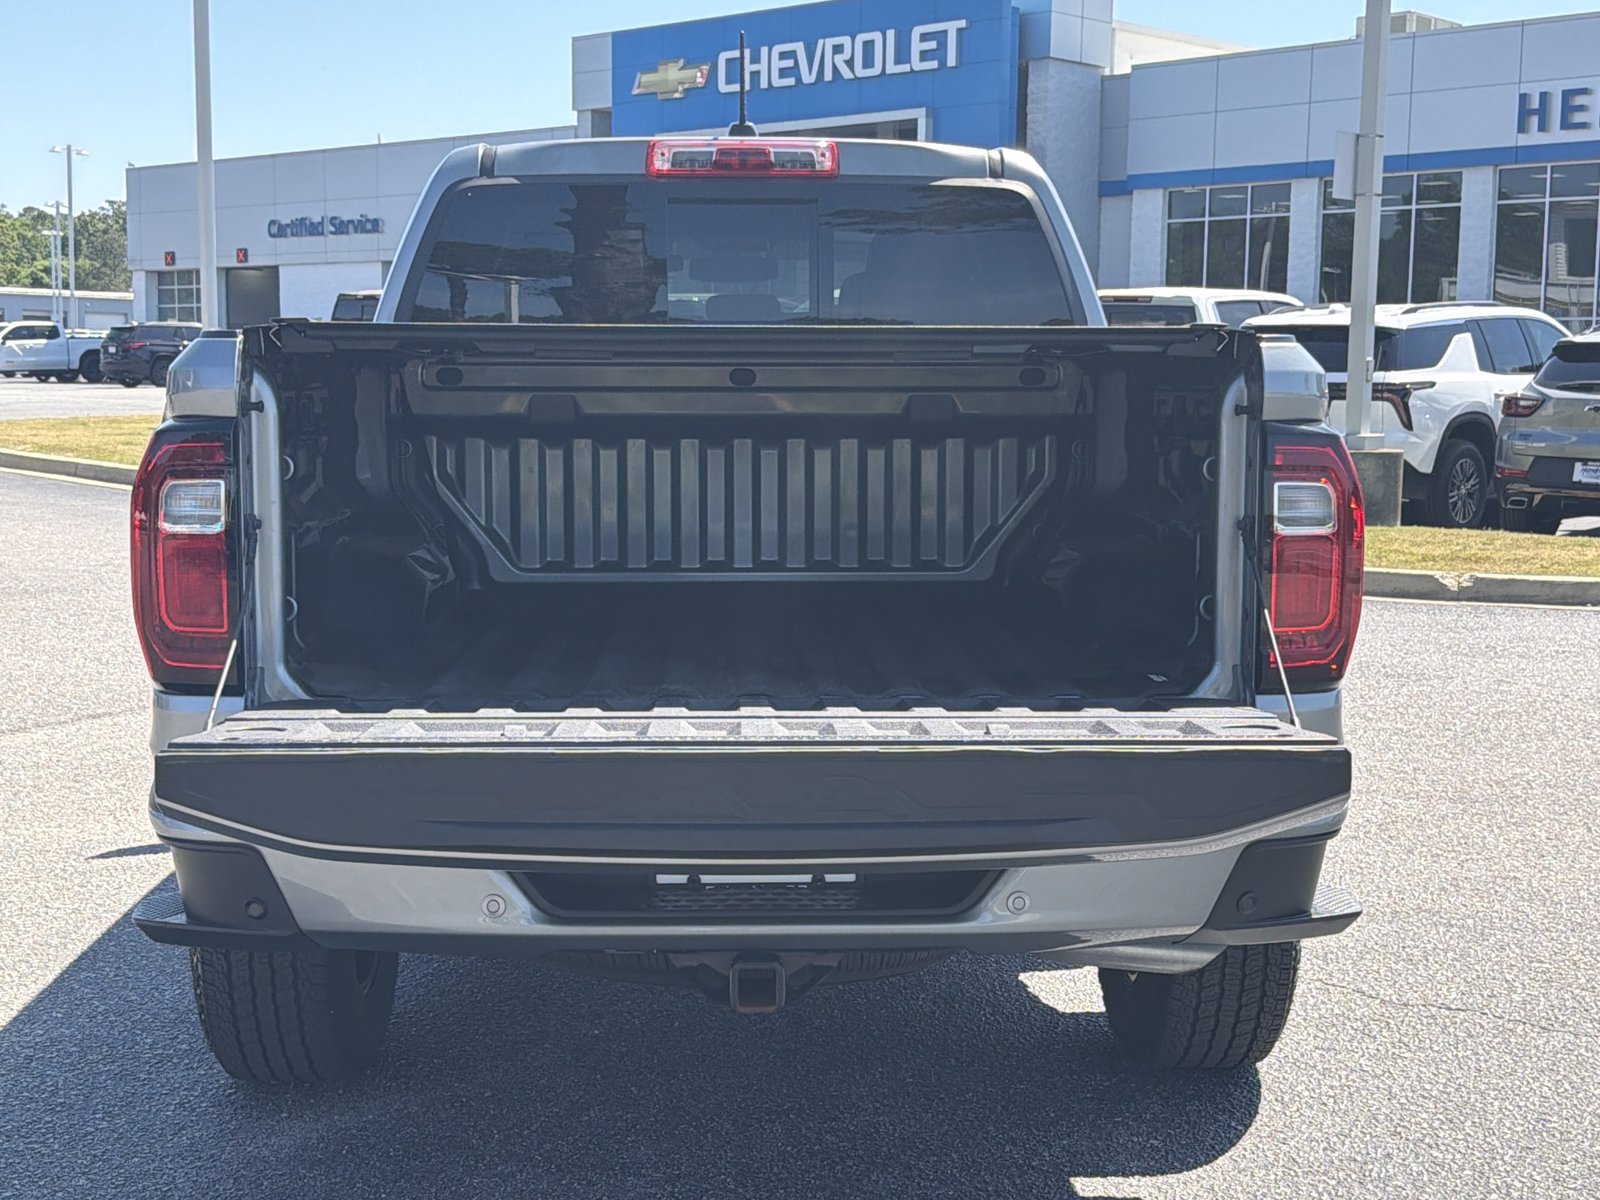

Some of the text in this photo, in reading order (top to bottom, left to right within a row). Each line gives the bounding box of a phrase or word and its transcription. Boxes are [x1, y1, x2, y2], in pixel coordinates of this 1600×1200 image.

[717, 18, 967, 94] CHEVROLET
[1517, 87, 1600, 134] HE
[267, 213, 384, 238] Certified Service
